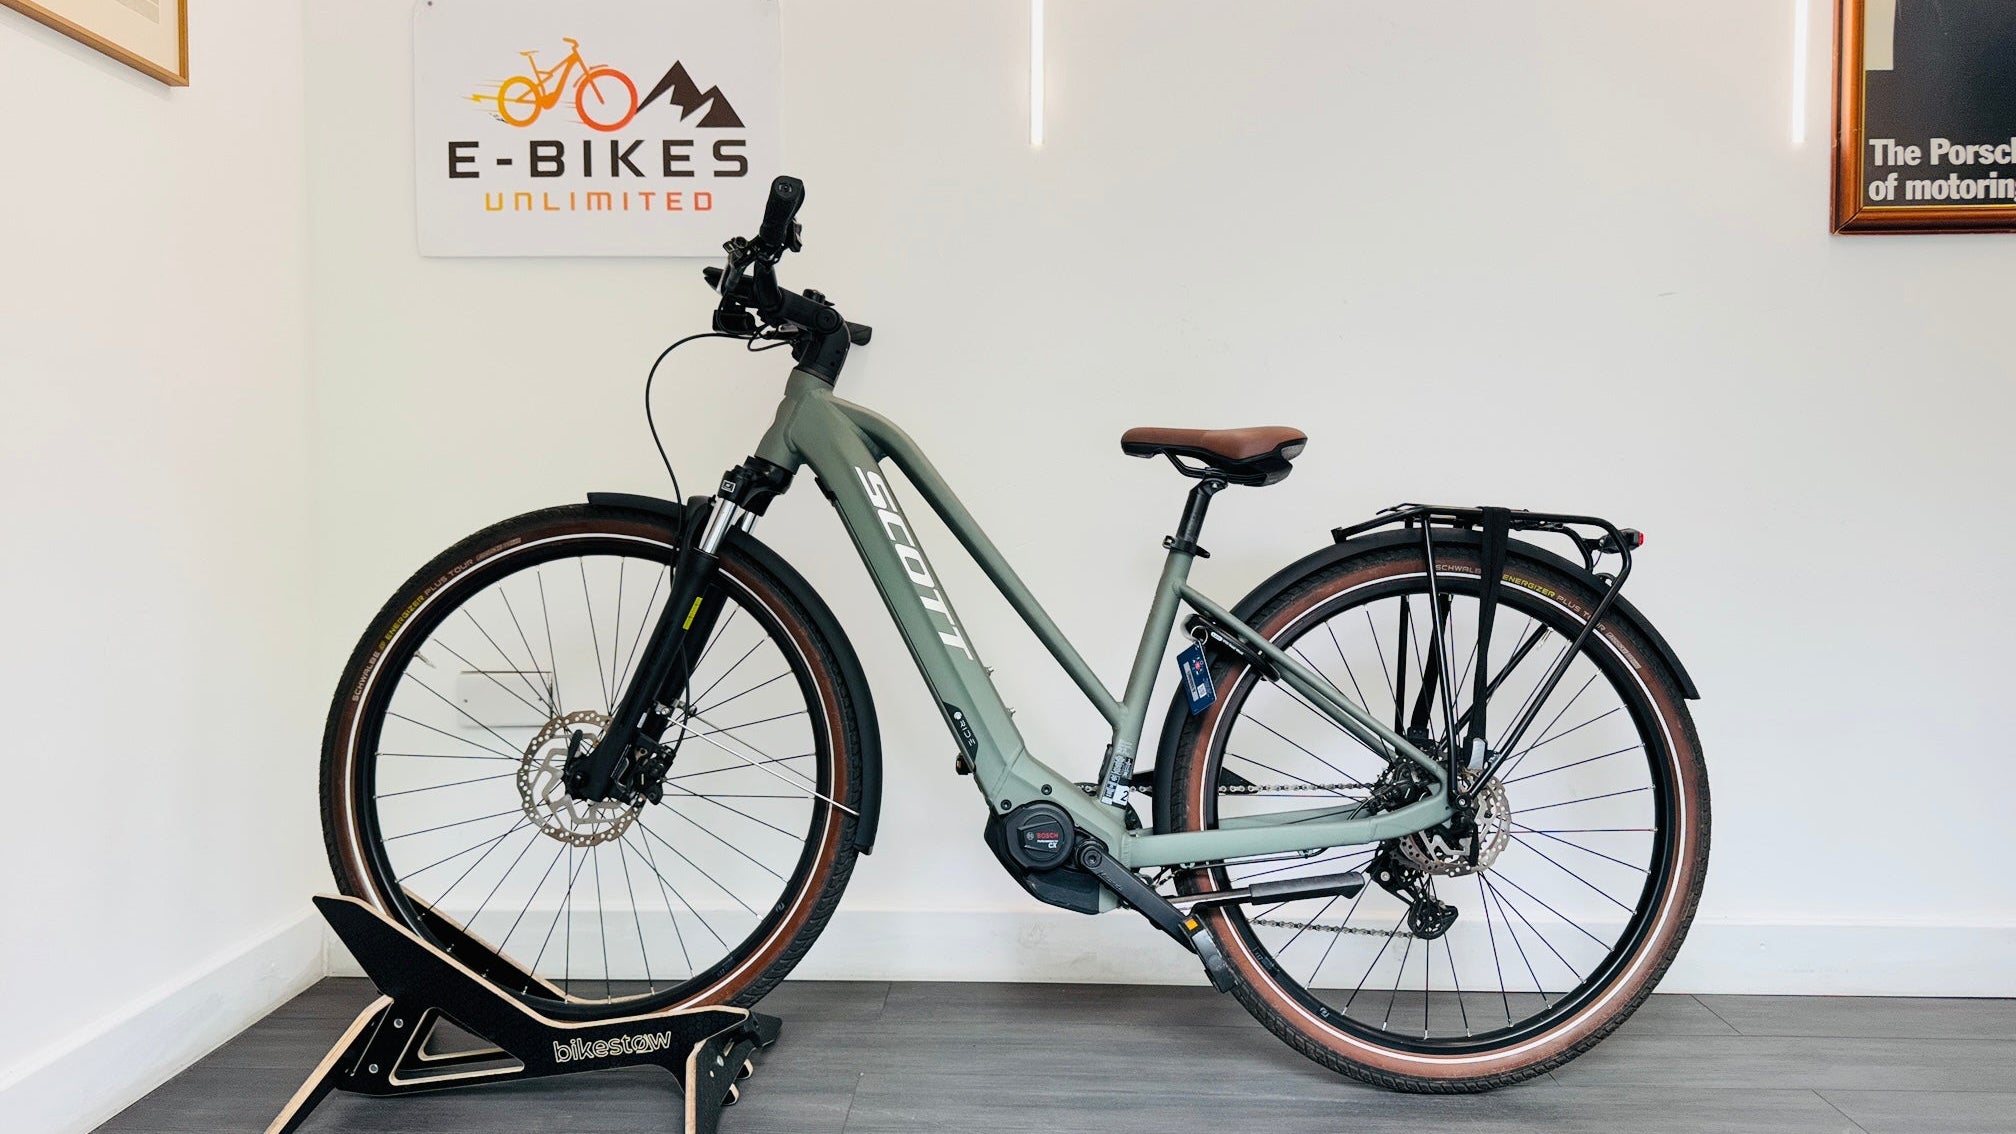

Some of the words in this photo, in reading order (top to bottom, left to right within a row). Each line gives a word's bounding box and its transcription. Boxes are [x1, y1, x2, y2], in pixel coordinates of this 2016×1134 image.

[448, 139, 749, 179] E-BIKES
[1868, 138, 1922, 167] The
[485, 191, 713, 212] UNLIMITED
[1868, 172, 1899, 201] of
[1905, 171, 2016, 202] motorin
[854, 466, 974, 661] SCOTT
[1435, 564, 1482, 575] SCHWALB
[1502, 573, 1556, 598] ENERGIZER
[1556, 595, 1582, 613] PLUS
[351, 650, 381, 702] SCHWALBE
[384, 595, 425, 640] ENERGIZER
[424, 575, 448, 596] PLUS
[448, 558, 473, 577] TOUR
[1120, 790, 1129, 802] 2
